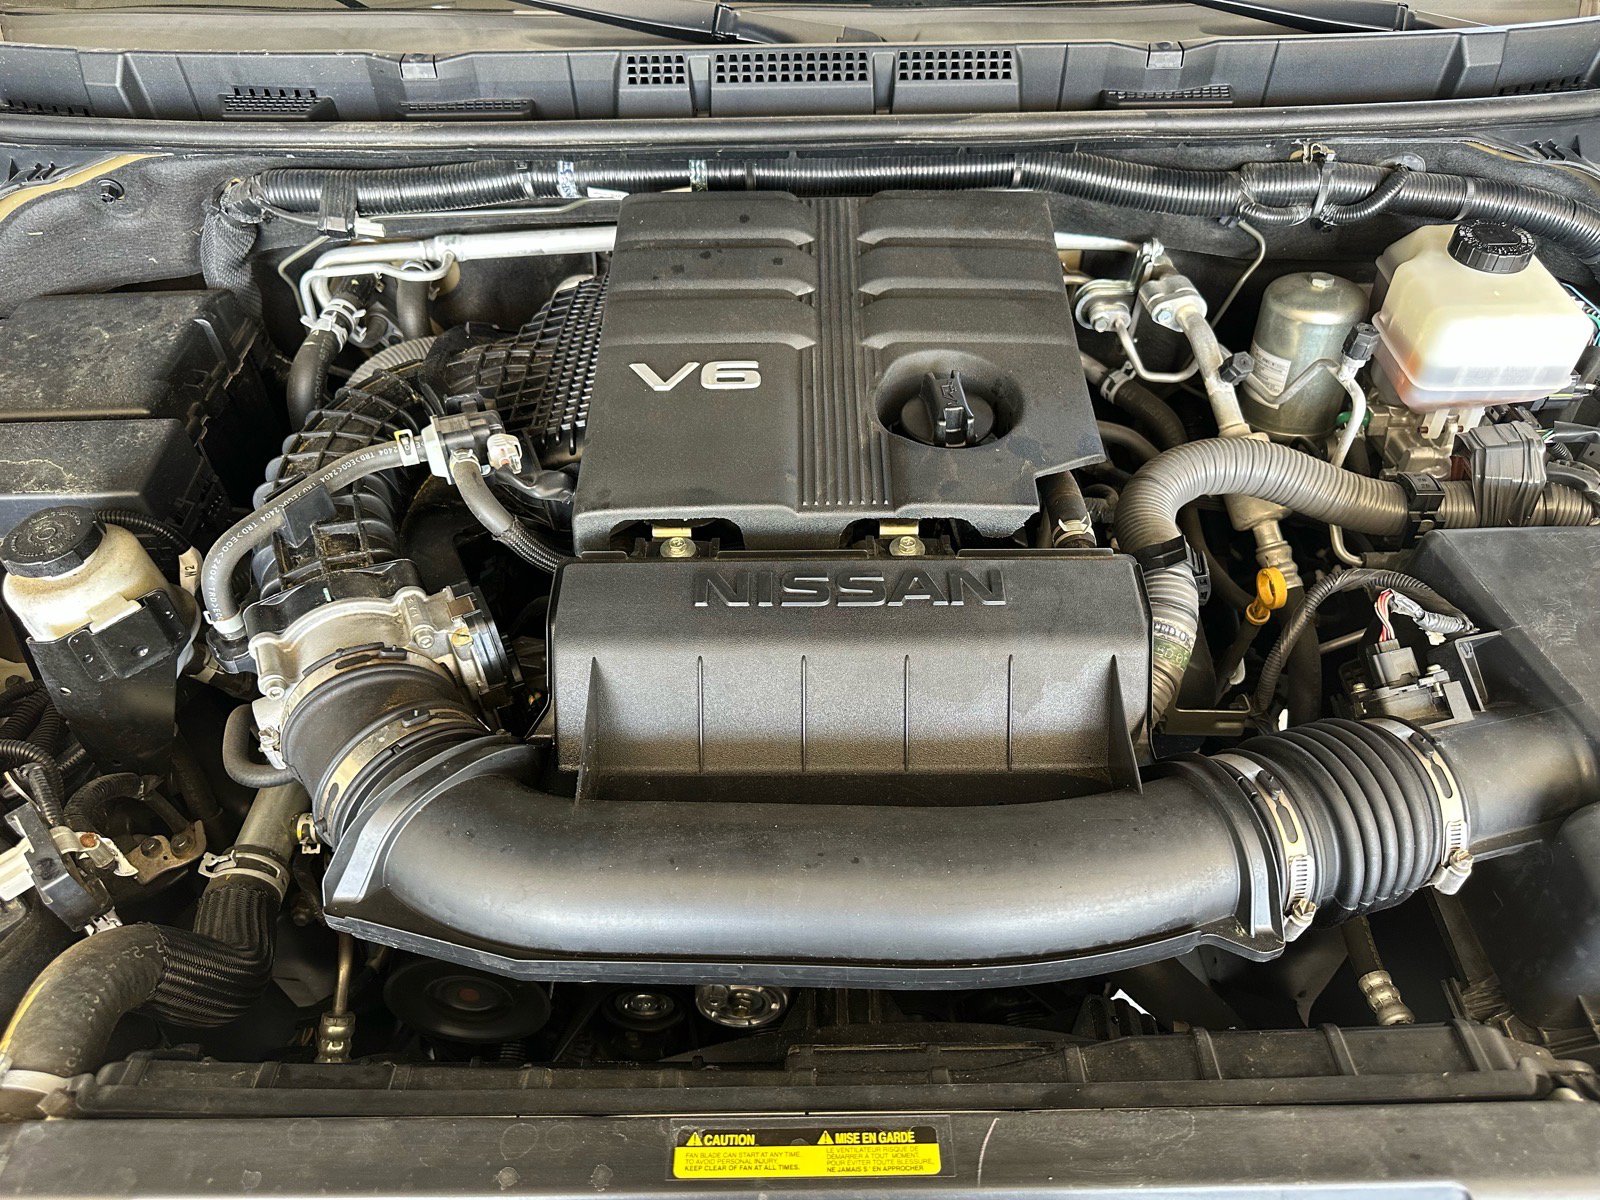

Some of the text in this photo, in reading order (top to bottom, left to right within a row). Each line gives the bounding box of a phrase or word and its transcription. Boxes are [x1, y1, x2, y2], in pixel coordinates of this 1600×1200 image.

[628, 360, 762, 392] V6
[694, 569, 1007, 607] NISSAN
[704, 1134, 755, 1146] CAUTION
[834, 1131, 916, 1144] MISE EN GARDE
